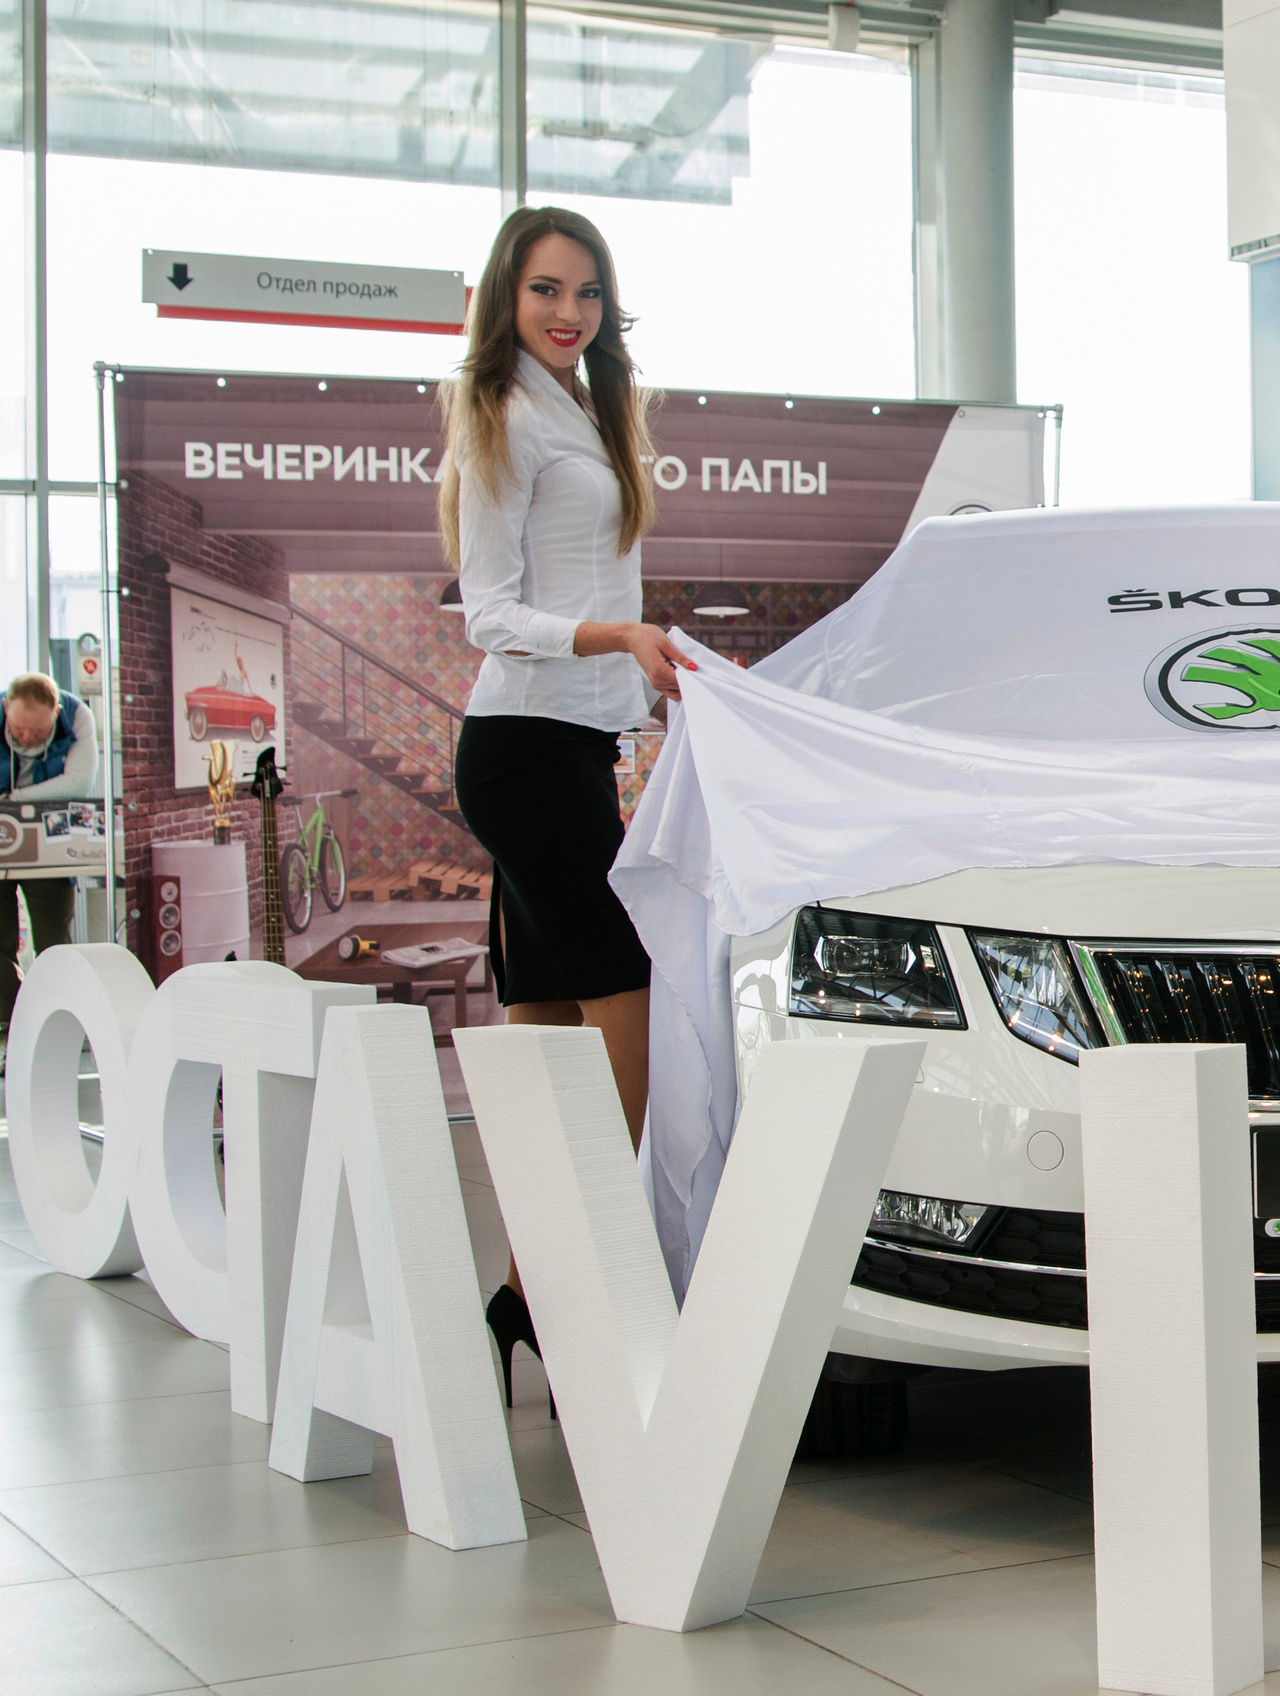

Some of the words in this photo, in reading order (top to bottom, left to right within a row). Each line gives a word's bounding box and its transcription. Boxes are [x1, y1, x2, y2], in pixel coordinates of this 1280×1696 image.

[256, 271, 317, 294] Отдел
[322, 280, 399, 299] продаж
[701, 456, 828, 495] ПАПЫ
